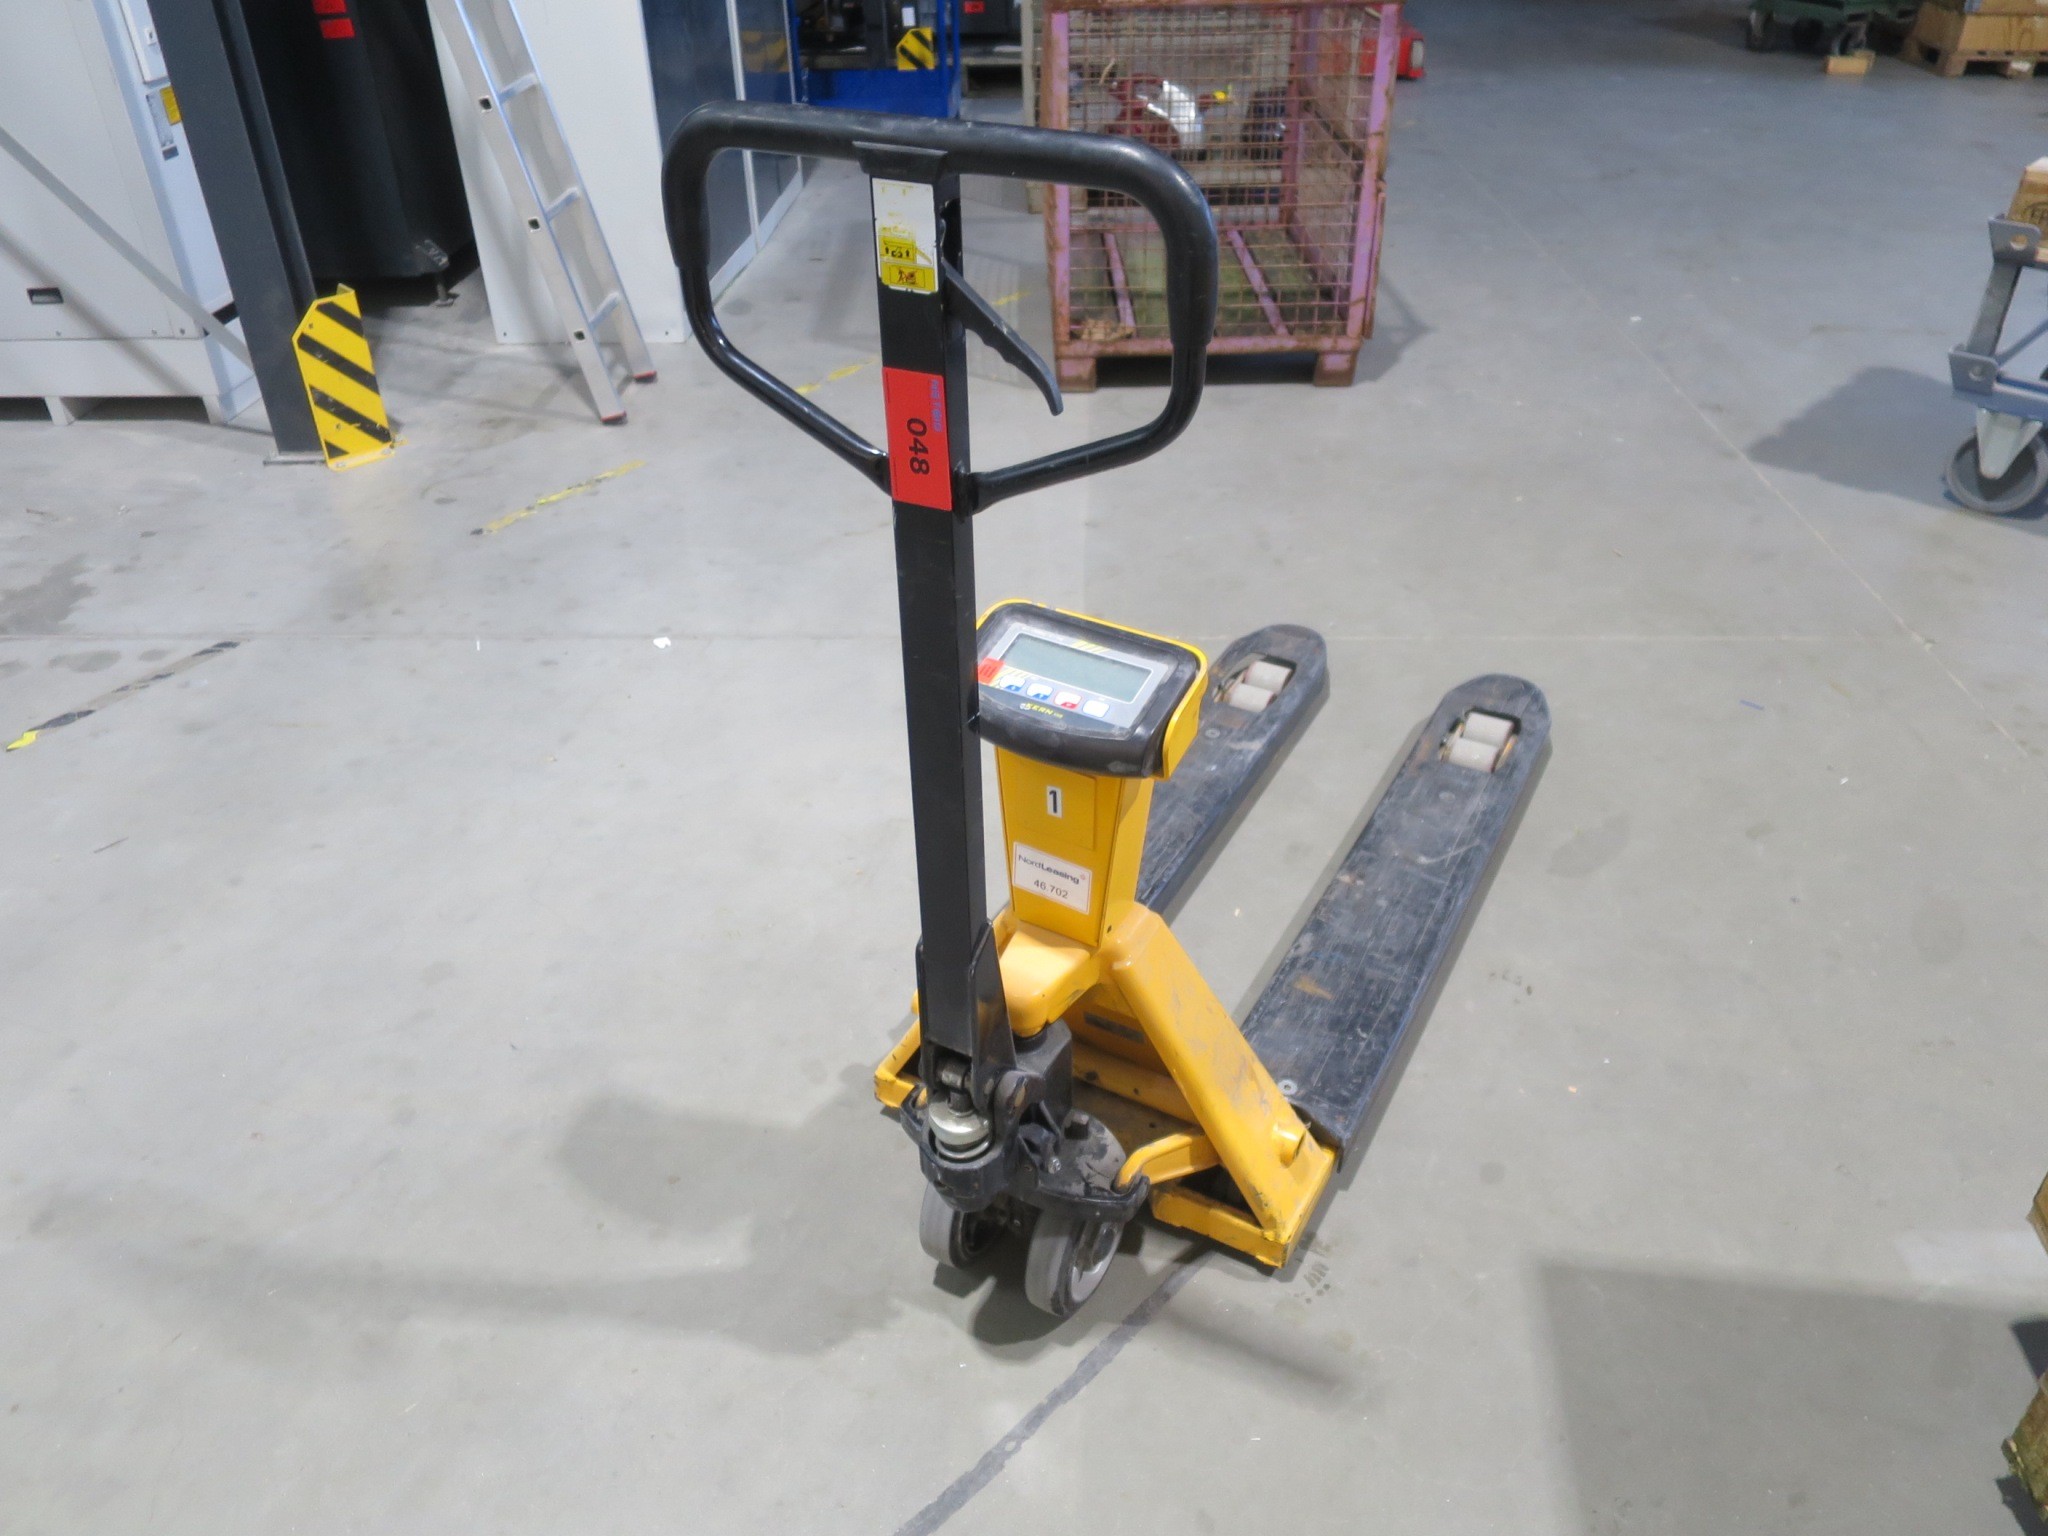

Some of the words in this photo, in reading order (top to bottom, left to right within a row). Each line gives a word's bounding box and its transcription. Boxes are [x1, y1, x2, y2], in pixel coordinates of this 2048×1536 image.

[907, 418, 930, 475] 048
[1025, 702, 1054, 716] KERN
[1048, 789, 1058, 814] 1
[1018, 854, 1080, 885] NordLeasing
